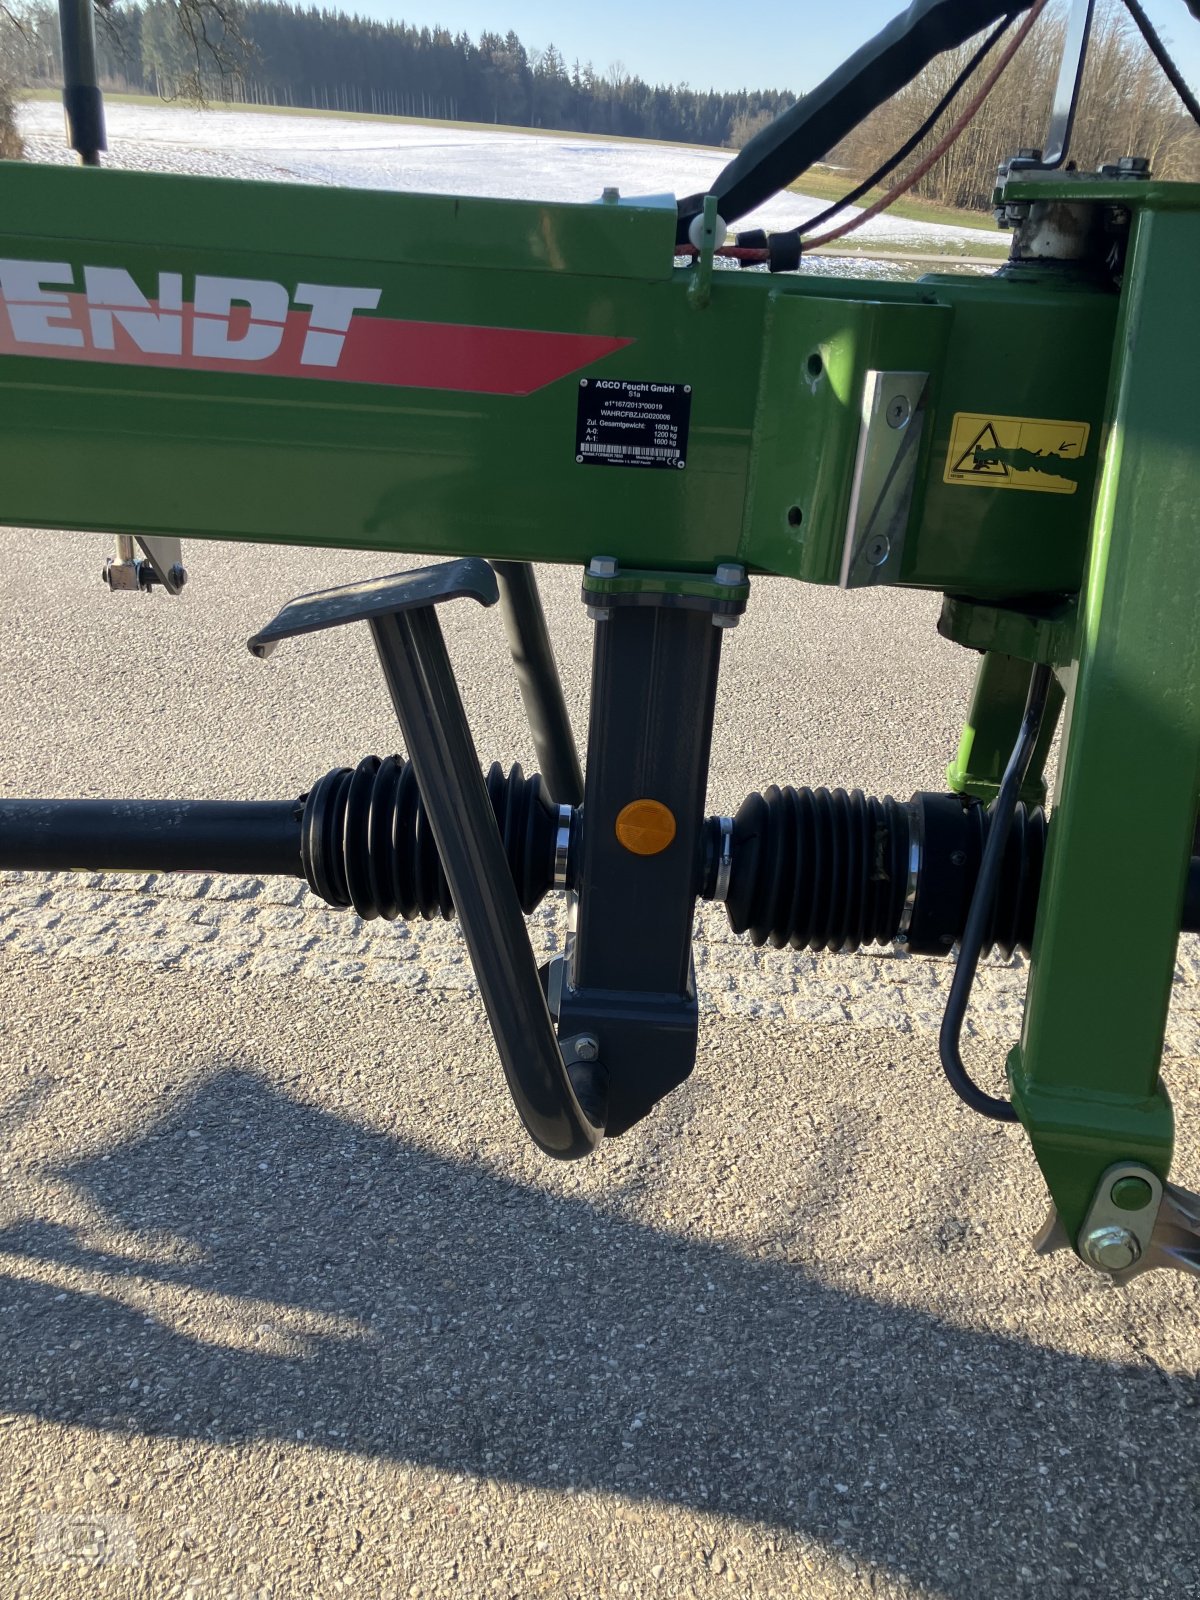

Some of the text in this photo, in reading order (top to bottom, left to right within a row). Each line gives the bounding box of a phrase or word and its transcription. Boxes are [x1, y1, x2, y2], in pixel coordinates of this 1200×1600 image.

[595, 381, 675, 393] AGCO Feucht GmbH
[670, 424, 678, 432] kg
[669, 432, 678, 440] kg
